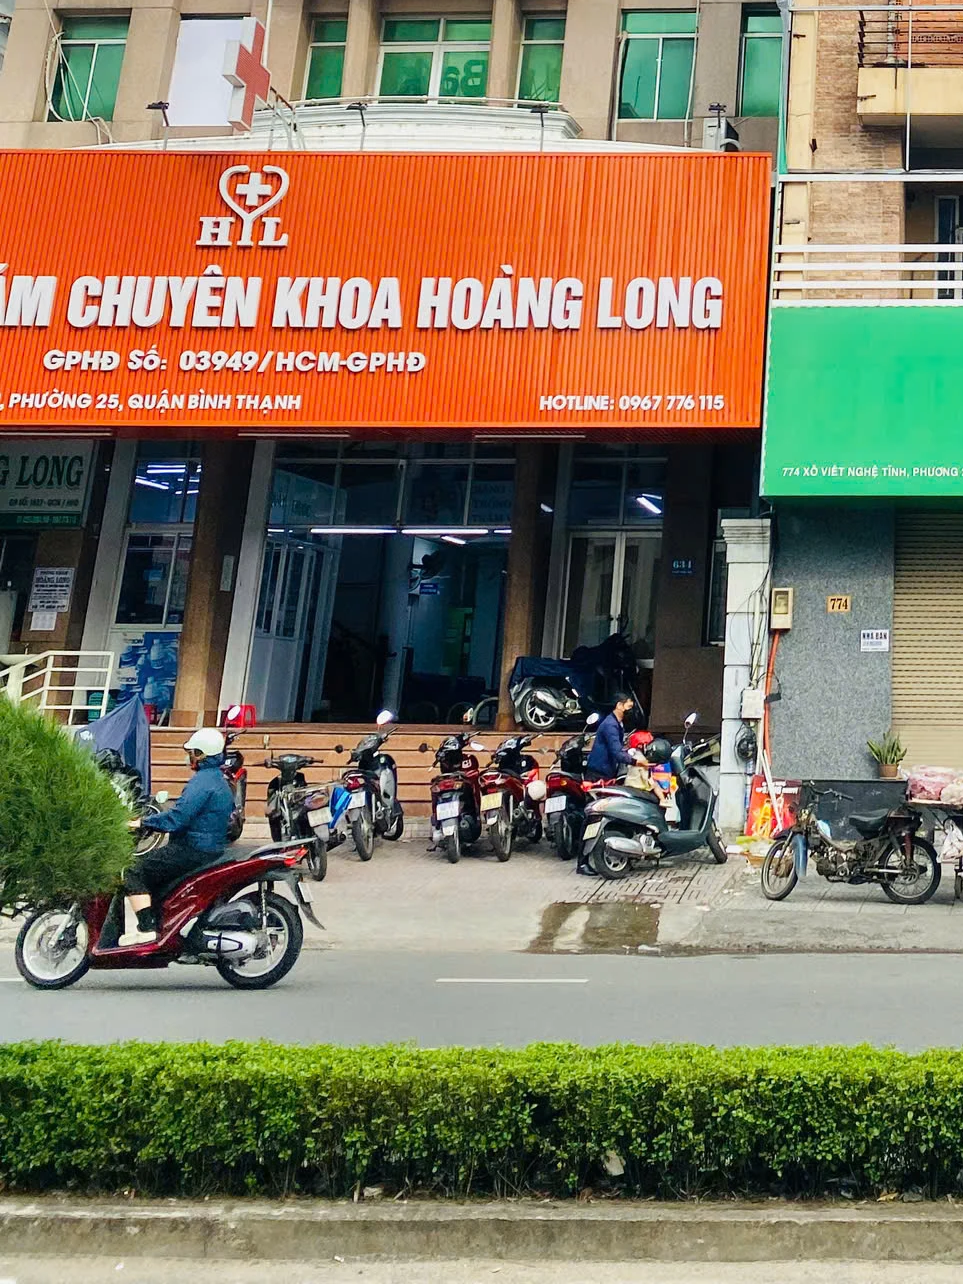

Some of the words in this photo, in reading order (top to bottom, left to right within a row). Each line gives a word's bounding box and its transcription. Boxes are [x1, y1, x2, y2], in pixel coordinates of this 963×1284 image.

[66, 264, 262, 329] CHUYÊN
[271, 276, 403, 330] KHOA
[416, 264, 584, 330] HOÀNG
[596, 276, 723, 330] LONG
[43, 349, 121, 372] GPHĐ
[9, 388, 92, 410] PHƯỜNG
[96, 393, 124, 413] 25,
[128, 389, 185, 414] QUẬN
[188, 388, 232, 410] BÌNH
[235, 394, 302, 415] THẠNH
[539, 394, 615, 412] HOTLINE:
[618, 394, 661, 411] 0967
[665, 395, 695, 411] 776
[698, 395, 725, 411] 115
[15, 454, 84, 488] LONG
[782, 467, 800, 477] 774
[830, 597, 849, 610] 774
